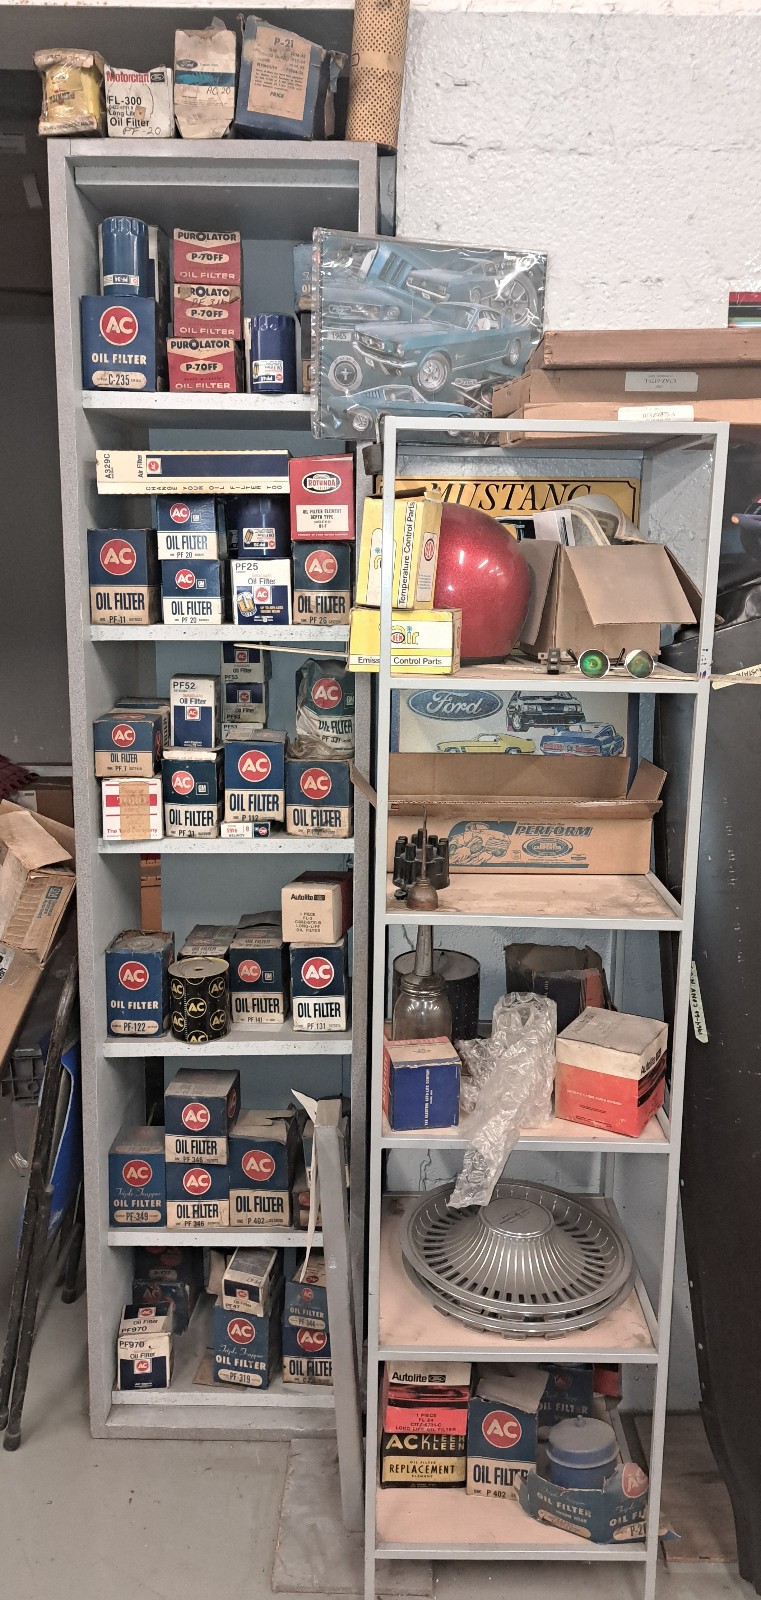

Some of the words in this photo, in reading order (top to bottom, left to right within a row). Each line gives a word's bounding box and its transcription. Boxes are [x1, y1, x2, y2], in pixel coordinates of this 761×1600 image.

[273, 37, 295, 48] P-21
[106, 71, 149, 83] Motorcraft
[221, 86, 231, 95] 20
[270, 91, 284, 99] PRICE
[108, 96, 142, 106] FL-300
[110, 117, 123, 127] Oil
[125, 117, 150, 128] Filter
[177, 231, 237, 243] PUROLATOR
[191, 252, 224, 261] P-70FF
[200, 272, 235, 280] FILTER
[177, 285, 230, 297] ROLATO
[191, 309, 224, 317] P-70FF
[106, 315, 133, 334] AC
[199, 328, 235, 336] FILTER
[332, 332, 347, 340] 1965
[170, 338, 230, 351] PUROLATOR
[91, 352, 109, 364] OIL
[112, 353, 147, 365] FILTER
[186, 363, 218, 371] P-70FF
[108, 374, 130, 386] C-235
[104, 453, 112, 479] A329C
[307, 478, 337, 487] ROTUNDA
[171, 507, 188, 518] AC
[407, 501, 416, 523] Parts
[165, 535, 180, 550] OIL
[181, 535, 208, 550] FILTER
[403, 524, 413, 553] Control
[104, 547, 132, 565] AC
[235, 562, 259, 571] PF25
[309, 558, 335, 573] AC
[177, 574, 193, 583] AC
[247, 577, 257, 585] Oil
[399, 554, 411, 605] Temperature
[96, 592, 112, 610] OIL
[114, 592, 145, 610] FILTER
[297, 595, 313, 614] OIL
[315, 595, 346, 613] FILTER
[171, 601, 184, 615] OIL
[186, 601, 212, 616] FILTER
[393, 656, 421, 665] Control
[422, 657, 442, 665] Parts
[172, 681, 196, 690] PF52
[314, 685, 339, 700] AC
[189, 697, 207, 705] Filter
[426, 691, 482, 714] Ford
[318, 719, 331, 734] OIL
[330, 718, 353, 734] FILTER
[114, 730, 134, 741] AC
[110, 752, 120, 763] OIL
[120, 752, 138, 763] FILTER
[241, 757, 268, 772] AC
[172, 778, 192, 788] AC
[304, 775, 329, 791] AC
[229, 793, 246, 812] OIL
[248, 793, 280, 812] FILTER
[169, 809, 183, 826] OIL
[184, 809, 214, 827] FILTER
[248, 814, 259, 822] 112
[292, 808, 310, 827] OIL
[310, 808, 342, 828] FILTER
[514, 825, 593, 837] PERFORM
[290, 893, 314, 901] Autolite
[123, 968, 145, 983] AC
[240, 965, 258, 977] AC
[305, 965, 331, 980] AC
[172, 983, 183, 994] AC
[210, 980, 224, 994] AC
[110, 1000, 125, 1009] OIL
[127, 1000, 159, 1010] FILTER
[188, 1002, 205, 1013] AC
[235, 998, 248, 1013] OIL
[252, 998, 280, 1013] FILTER
[297, 1001, 312, 1017] OIL
[313, 1001, 341, 1018] FILTER
[173, 1017, 184, 1028] AC
[212, 1014, 225, 1027] AC
[306, 1022, 315, 1030] PF
[316, 1022, 326, 1030] 131
[123, 1022, 146, 1032] PF-122
[185, 1110, 207, 1123] AC
[175, 1138, 189, 1154] OIL
[191, 1139, 217, 1155] FILTER
[245, 1156, 272, 1173] AC
[126, 1167, 149, 1179] AC
[186, 1175, 209, 1187] AC
[113, 1199, 129, 1207] OIL
[131, 1199, 162, 1208] FILTER
[235, 1195, 252, 1213] OIL
[254, 1196, 284, 1213] FILTER
[126, 1211, 149, 1222] PF-349
[176, 1204, 190, 1218] OIL
[191, 1204, 219, 1219] FILTER
[289, 1307, 301, 1315] OIL
[302, 1308, 325, 1318] FILTER
[231, 1323, 252, 1338] AC
[300, 1330, 324, 1344] AC
[139, 1351, 156, 1359] Filter
[215, 1354, 231, 1366] OIL
[234, 1358, 267, 1371] FILTER
[229, 1371, 251, 1384] PF-319
[391, 1371, 427, 1383] Autolite
[486, 1418, 518, 1439] AC
[389, 1464, 456, 1475] REPLACEMENT
[536, 1491, 553, 1506] OIL
[556, 1499, 592, 1518] FILTER
